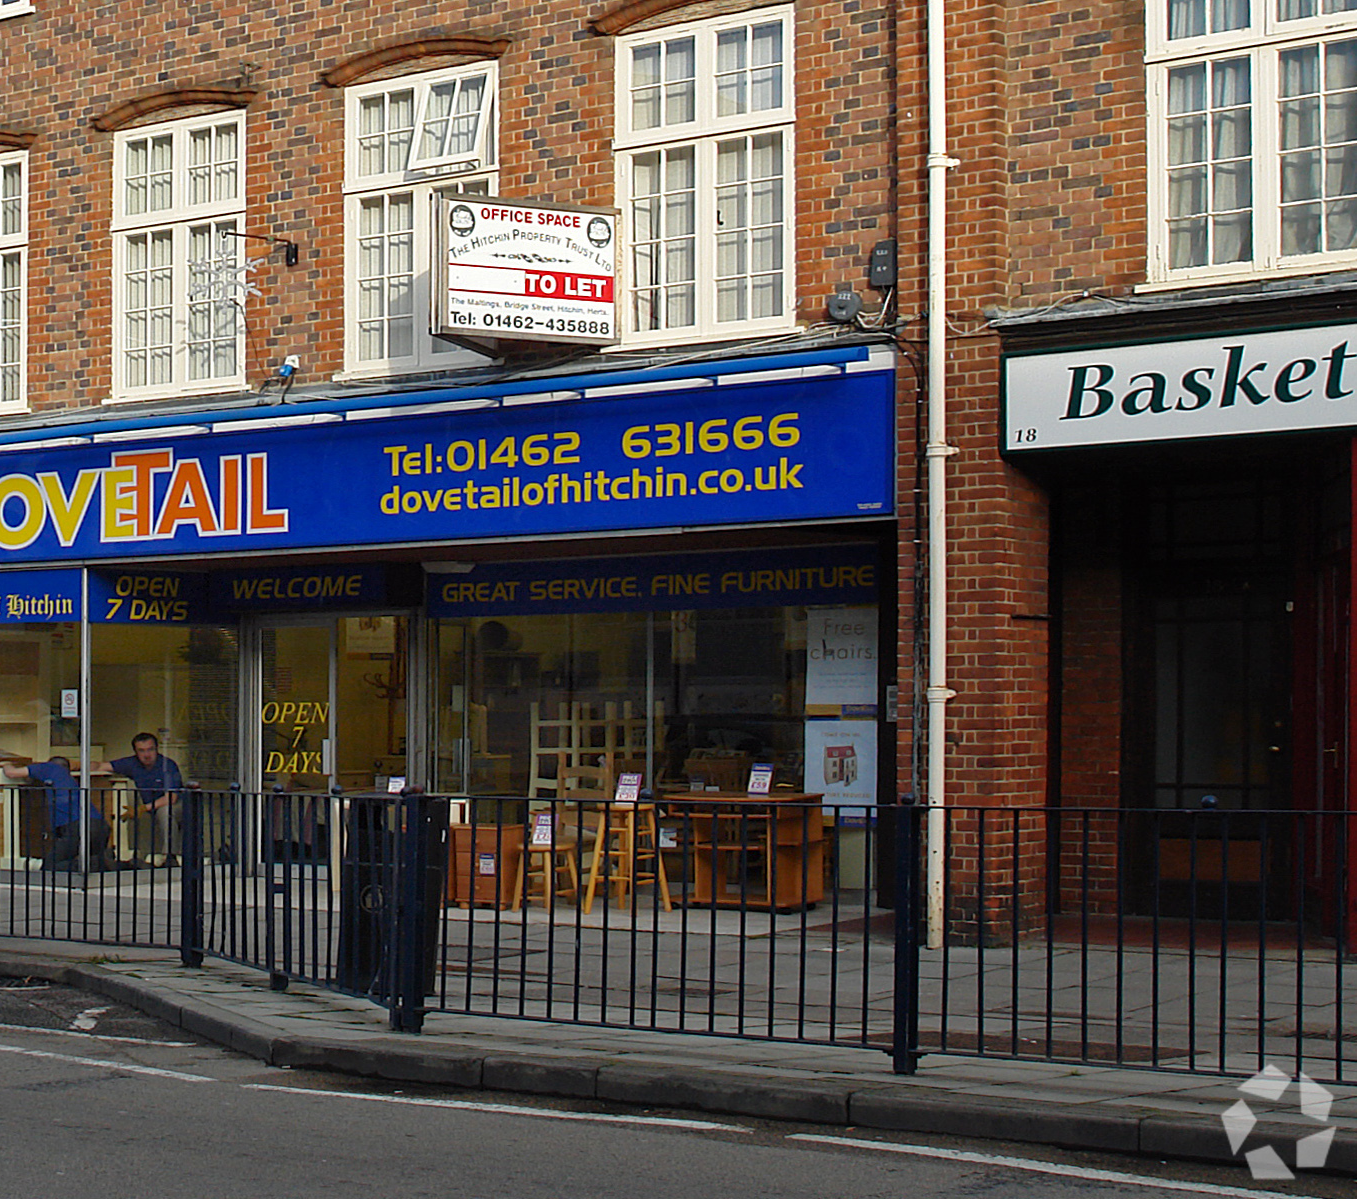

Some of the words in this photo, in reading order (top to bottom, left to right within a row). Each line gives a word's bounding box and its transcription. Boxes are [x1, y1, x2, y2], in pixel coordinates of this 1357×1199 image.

[481, 207, 533, 224] OFFICE
[537, 213, 581, 228] SPACE
[449, 243, 470, 260] THE
[471, 232, 510, 250] HITCHIN
[512, 229, 562, 246] PROPERTY
[565, 237, 594, 259] TRUST
[594, 253, 611, 273] LTD
[525, 273, 557, 294] TO
[565, 277, 607, 298] LET
[504, 301, 529, 311] Bridge
[451, 312, 477, 326] Tel:
[482, 313, 610, 335] 01462-435888
[621, 412, 801, 459] 631666
[1014, 427, 1038, 443] 18
[379, 458, 804, 515] dovetailofhitchin.co.uk
[115, 575, 181, 598] OPEN
[232, 575, 363, 599] WELCOME
[442, 581, 521, 603] GREAT
[651, 573, 711, 597] FINE
[720, 565, 875, 593] FURNITURE
[6, 593, 73, 620] Hitchin
[105, 599, 123, 620] 7
[130, 599, 189, 621] DAYS
[823, 617, 865, 636] Free
[261, 701, 330, 724] OPEN
[292, 725, 304, 748] 7
[264, 751, 323, 774] DAYS
